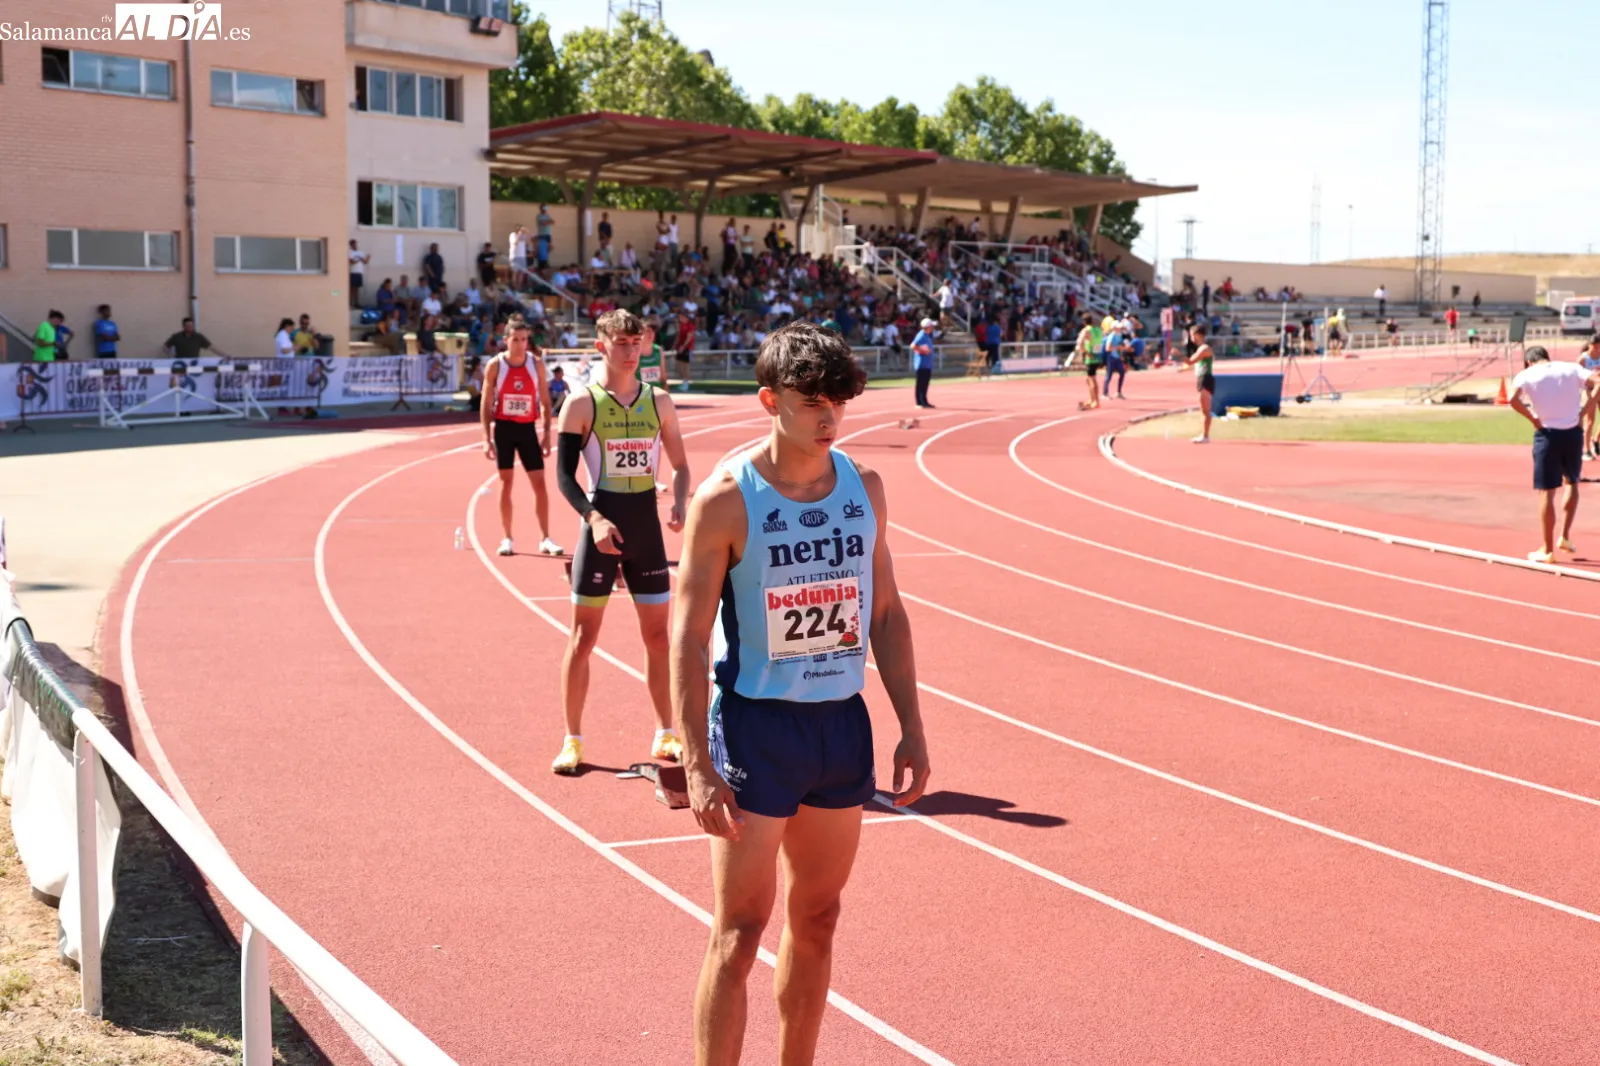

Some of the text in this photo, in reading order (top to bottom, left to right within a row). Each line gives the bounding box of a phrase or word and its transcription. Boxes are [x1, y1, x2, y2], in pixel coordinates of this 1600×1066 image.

[615, 451, 648, 468] 283
[800, 511, 828, 525] TROPS
[768, 527, 865, 567] nerja
[767, 583, 857, 611] bedunia
[784, 603, 847, 641] 224
